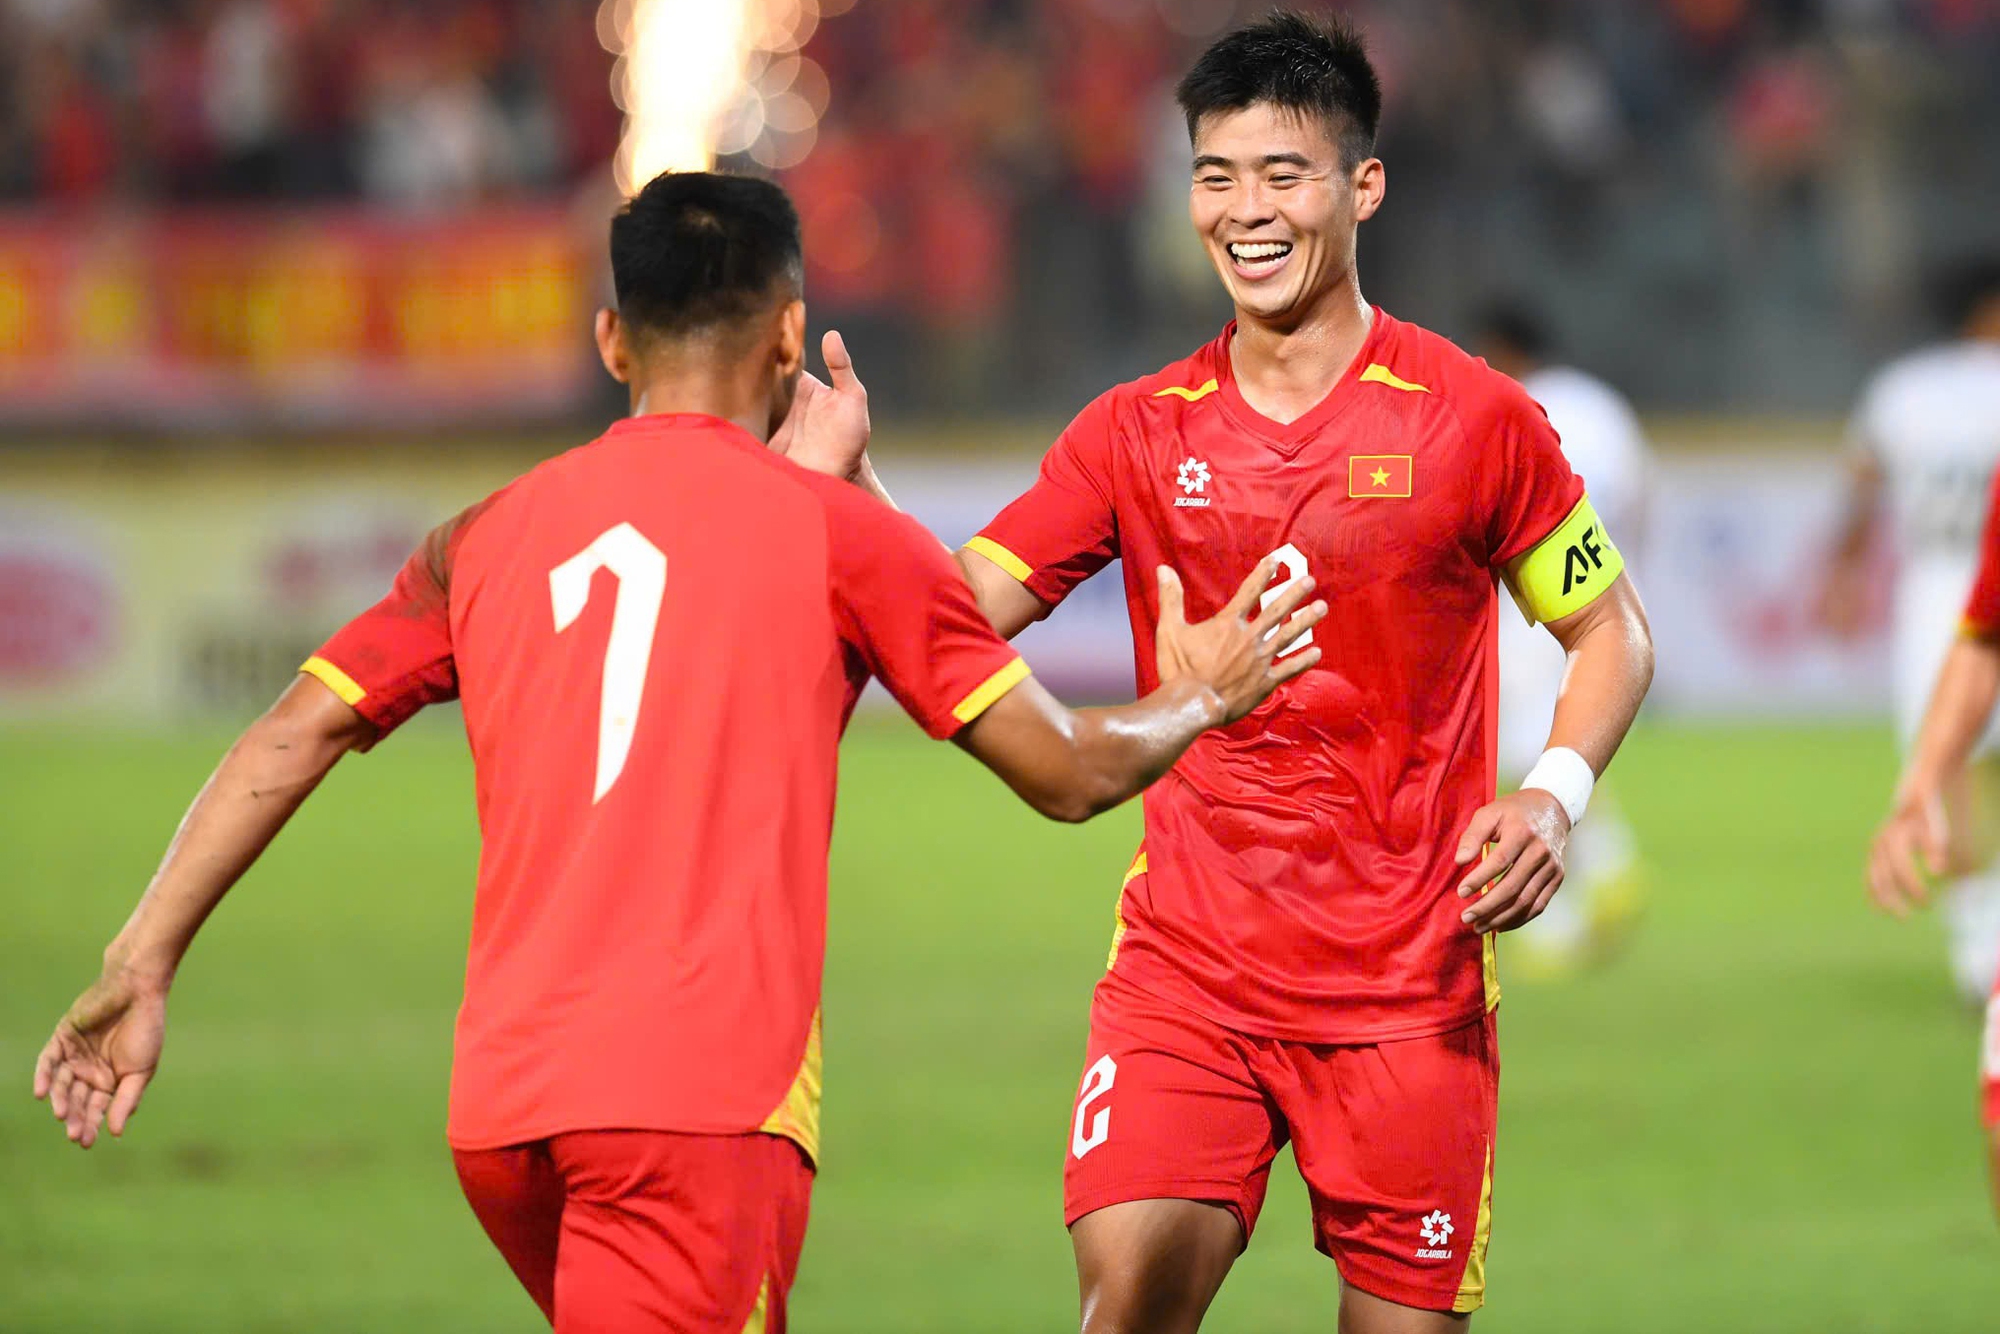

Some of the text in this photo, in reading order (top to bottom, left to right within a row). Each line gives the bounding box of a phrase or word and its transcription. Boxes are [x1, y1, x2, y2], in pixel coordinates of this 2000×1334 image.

[549, 521, 667, 806] 7
[1072, 1053, 1117, 1160] 2
[1414, 1248, 1452, 1259] JOGARBOLA
